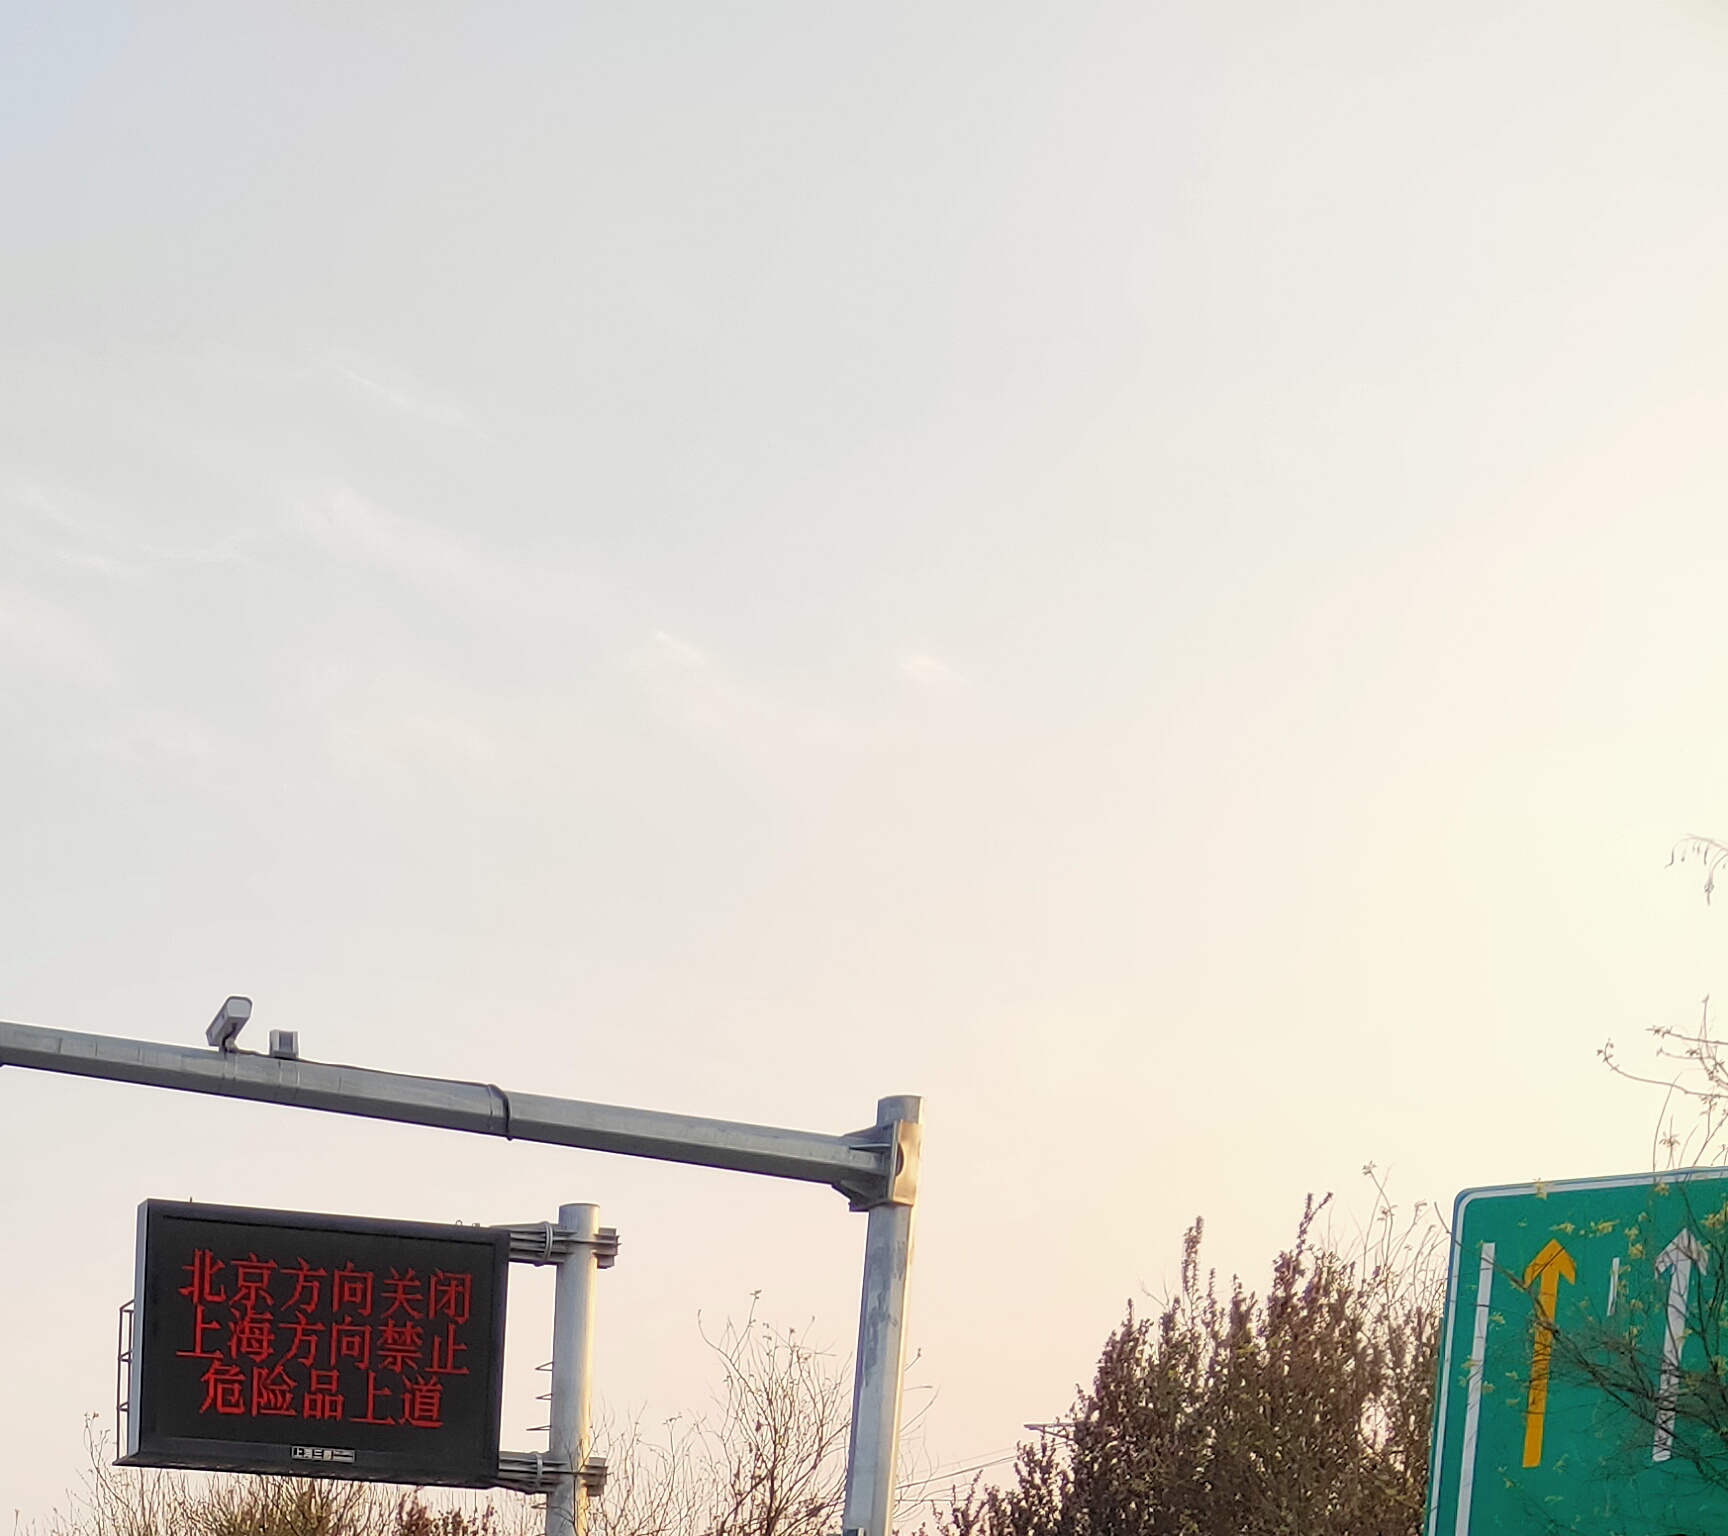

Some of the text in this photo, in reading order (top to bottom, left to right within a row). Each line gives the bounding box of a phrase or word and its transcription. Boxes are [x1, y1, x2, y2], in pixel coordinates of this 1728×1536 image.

[178, 1249, 471, 1324] 北京方向关闭
[176, 1304, 469, 1374] 上海方向禁止
[199, 1360, 443, 1428] 危险品上道
